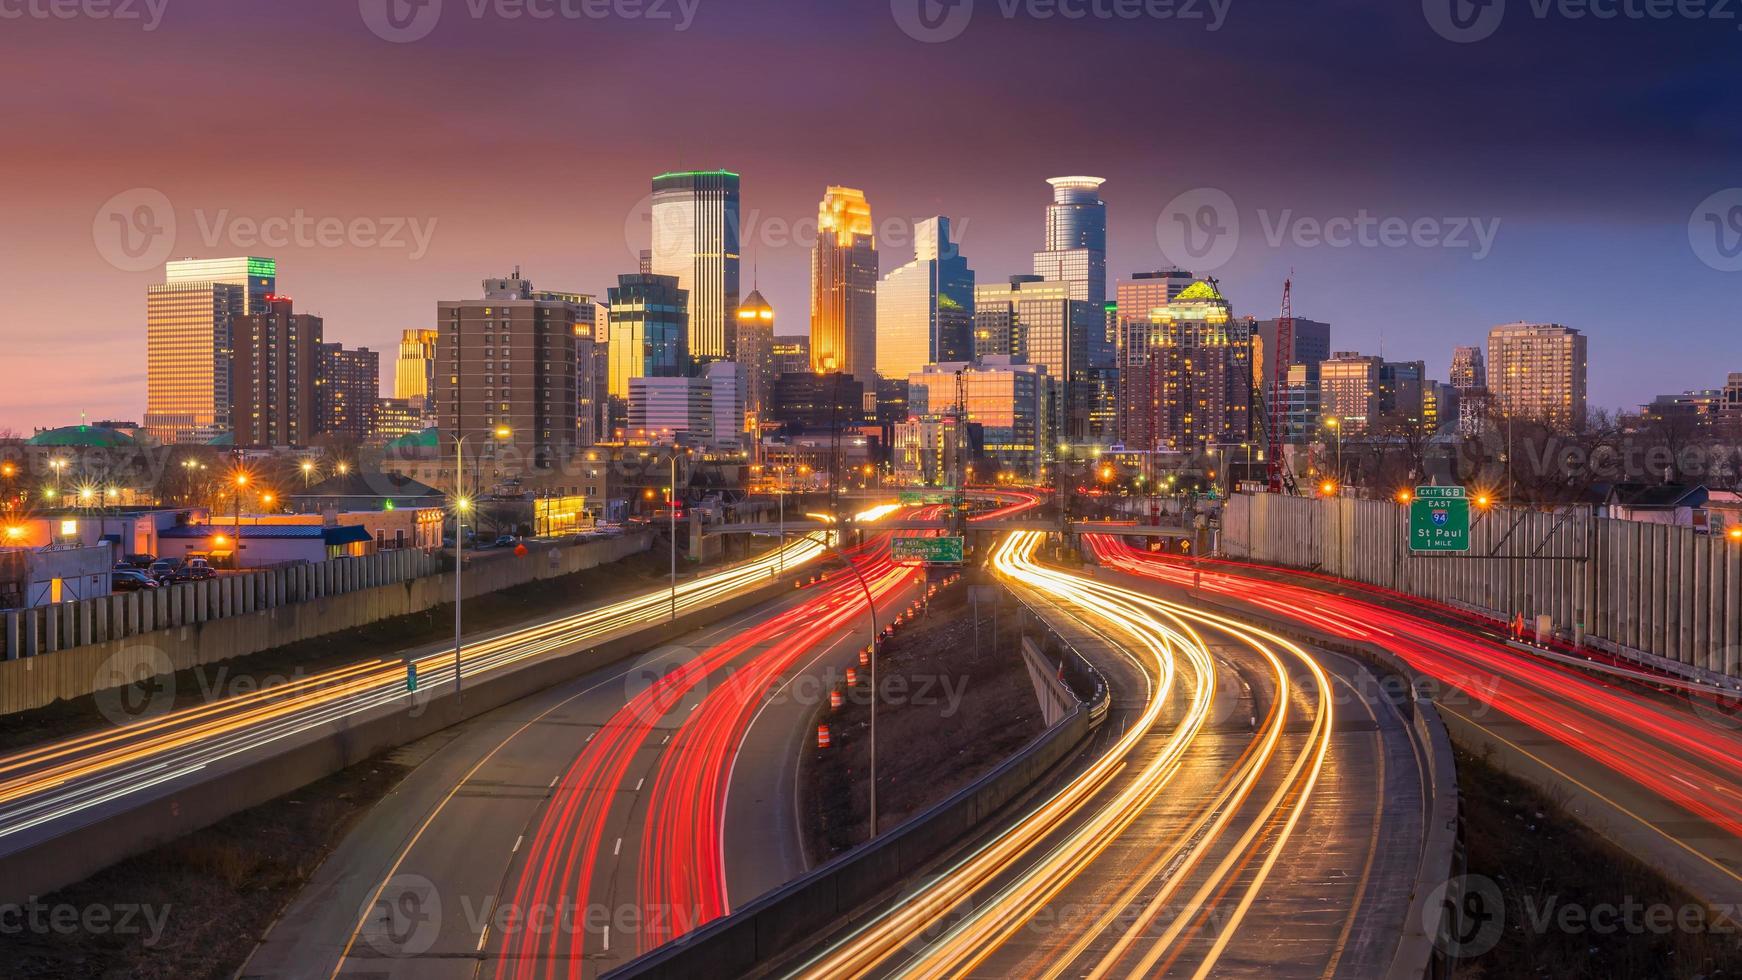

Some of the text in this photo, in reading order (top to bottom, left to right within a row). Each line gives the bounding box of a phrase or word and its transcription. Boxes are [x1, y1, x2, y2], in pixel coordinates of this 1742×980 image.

[1434, 514, 1446, 522] 94
[1418, 529, 1461, 537] St Paul
